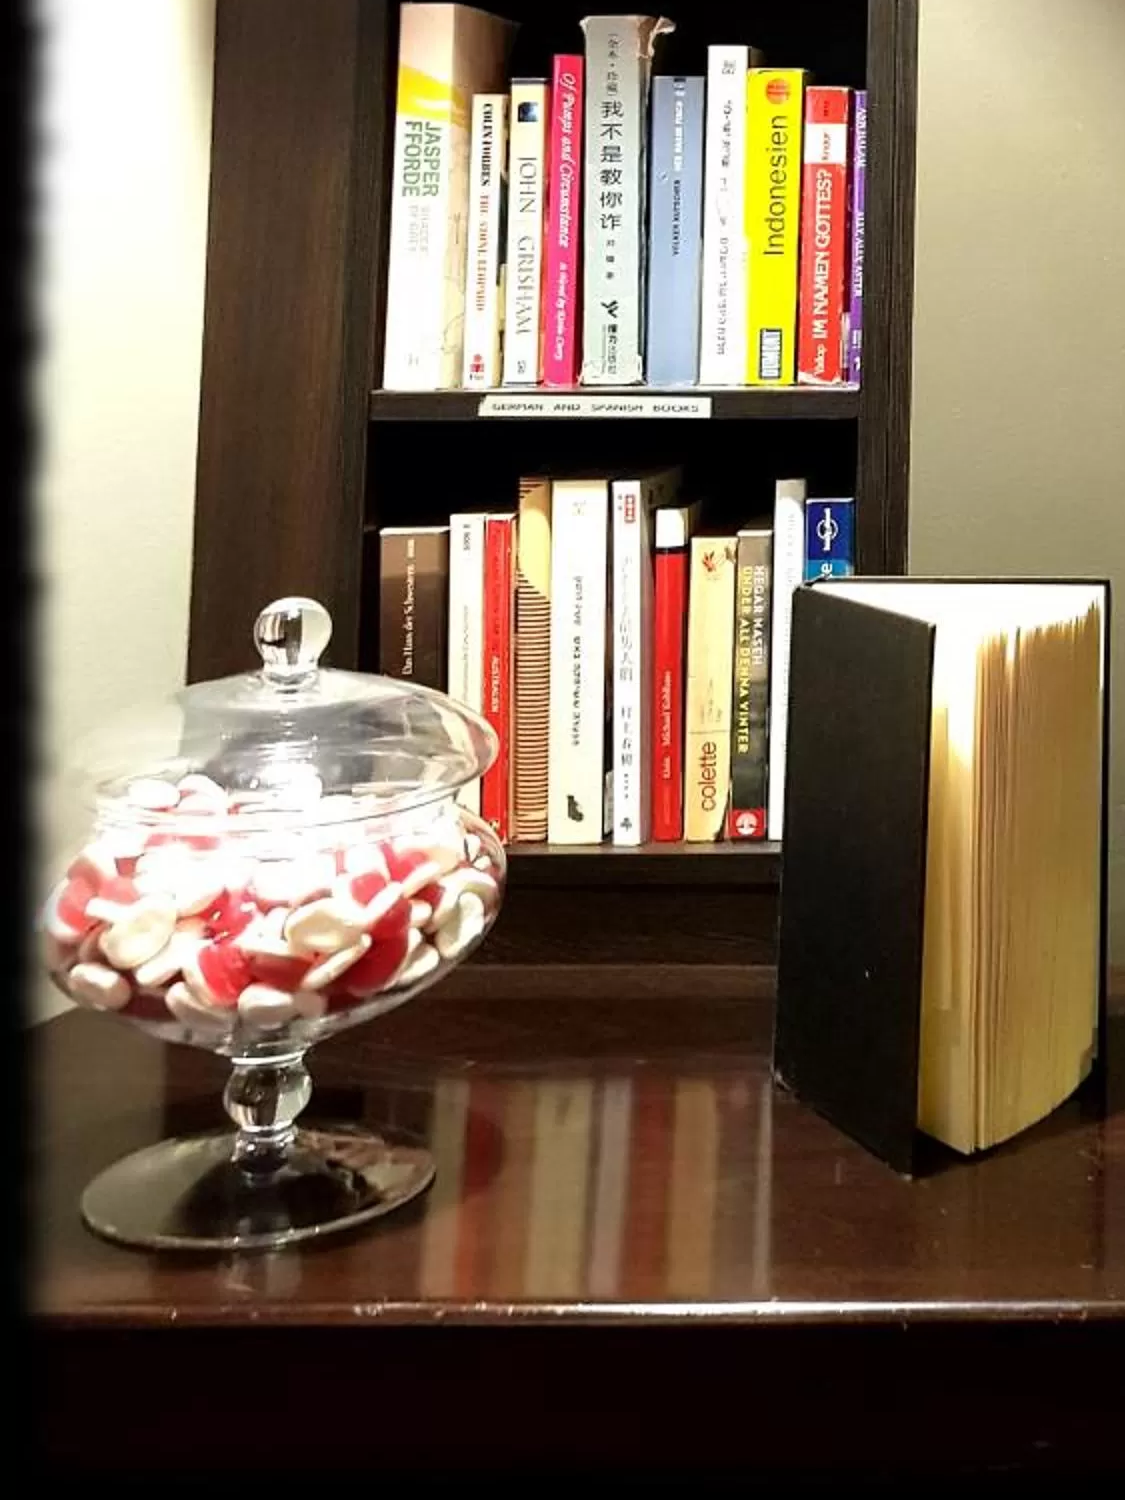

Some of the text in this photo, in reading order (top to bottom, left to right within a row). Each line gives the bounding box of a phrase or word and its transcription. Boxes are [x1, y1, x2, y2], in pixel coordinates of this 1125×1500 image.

[561, 72, 577, 92] Of
[482, 102, 494, 138] COLIN
[560, 136, 575, 162] and
[402, 119, 424, 197] FFORDE
[421, 120, 443, 196] JASPER
[480, 140, 492, 186] FORBES
[761, 116, 789, 257] Indonesien
[558, 163, 575, 248] Circumstance
[814, 170, 833, 249] GOTTES?
[515, 156, 538, 336] JOHN GRISHAM
[812, 252, 831, 317] NAMEN
[811, 320, 828, 341] IM
[553, 403, 581, 412] AND
[590, 403, 644, 413] SPANISH
[738, 565, 753, 754] UNDER ALL DENNA VINTER
[697, 741, 717, 812] colette
